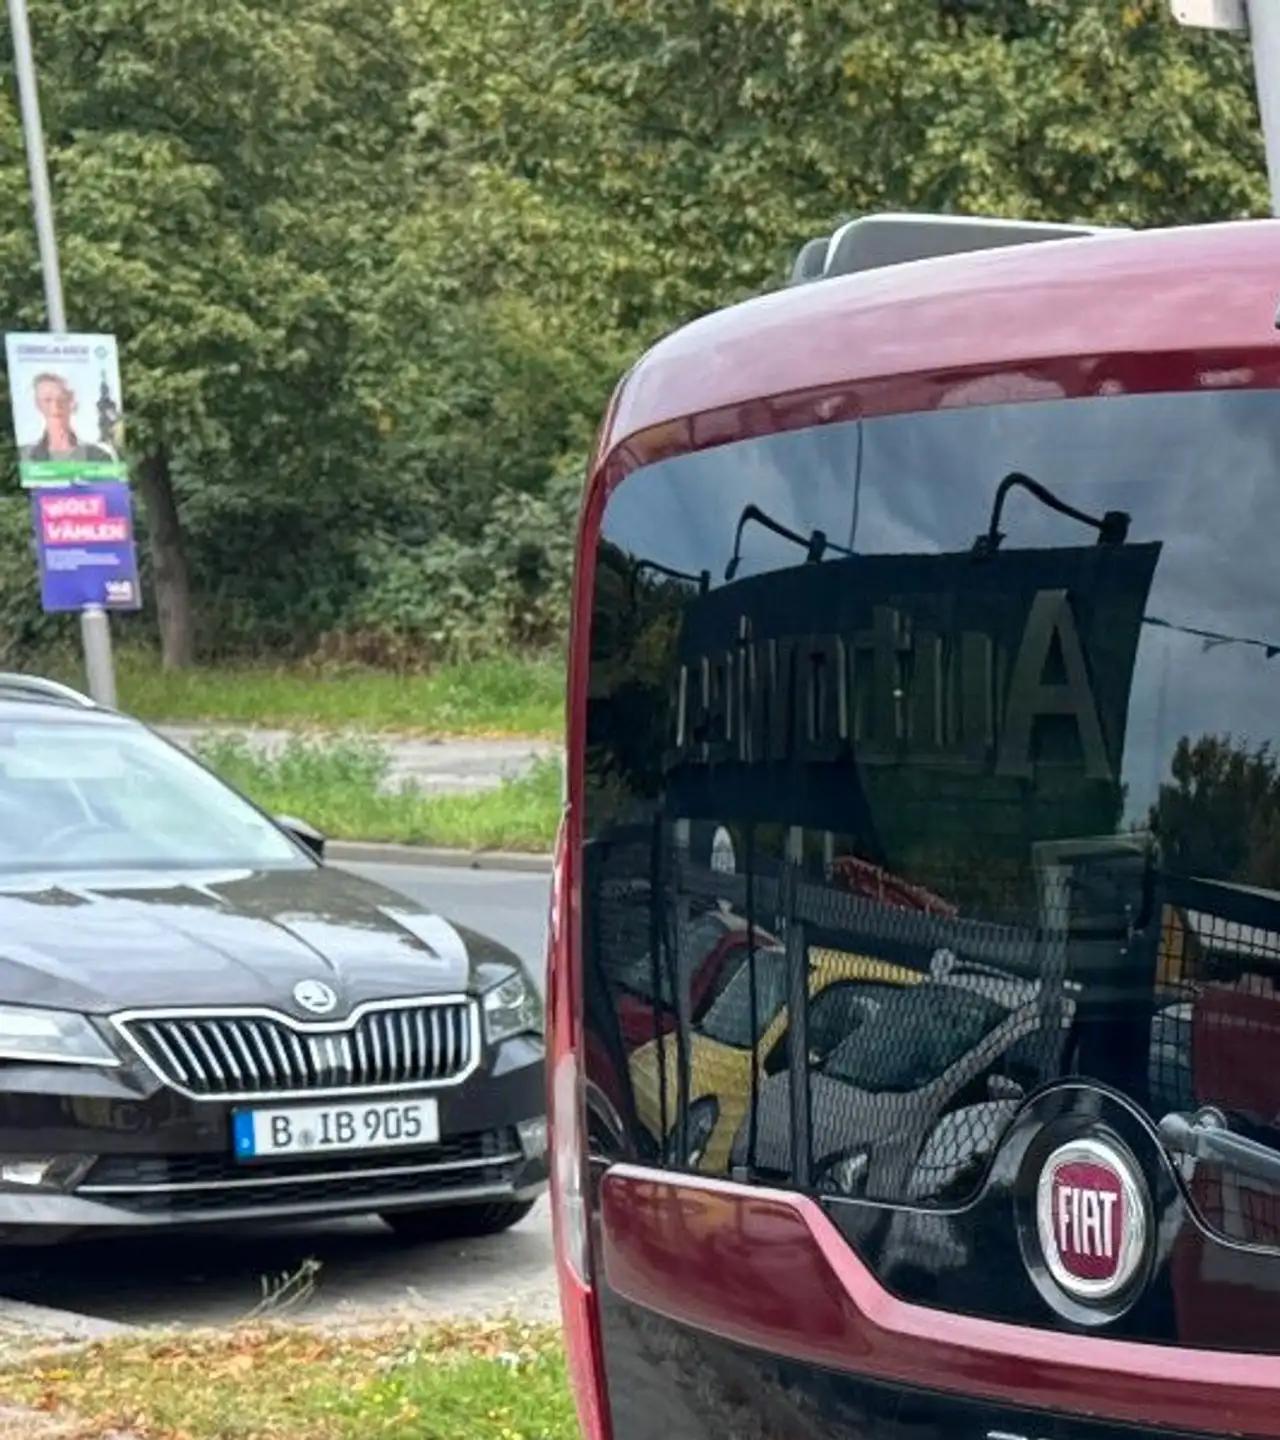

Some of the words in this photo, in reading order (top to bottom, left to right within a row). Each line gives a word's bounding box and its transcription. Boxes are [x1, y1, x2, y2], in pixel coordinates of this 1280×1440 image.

[271, 1115, 293, 1148] B
[319, 1111, 356, 1145] IB
[363, 1106, 422, 1142] 905
[1056, 1183, 1117, 1257] FIAT
